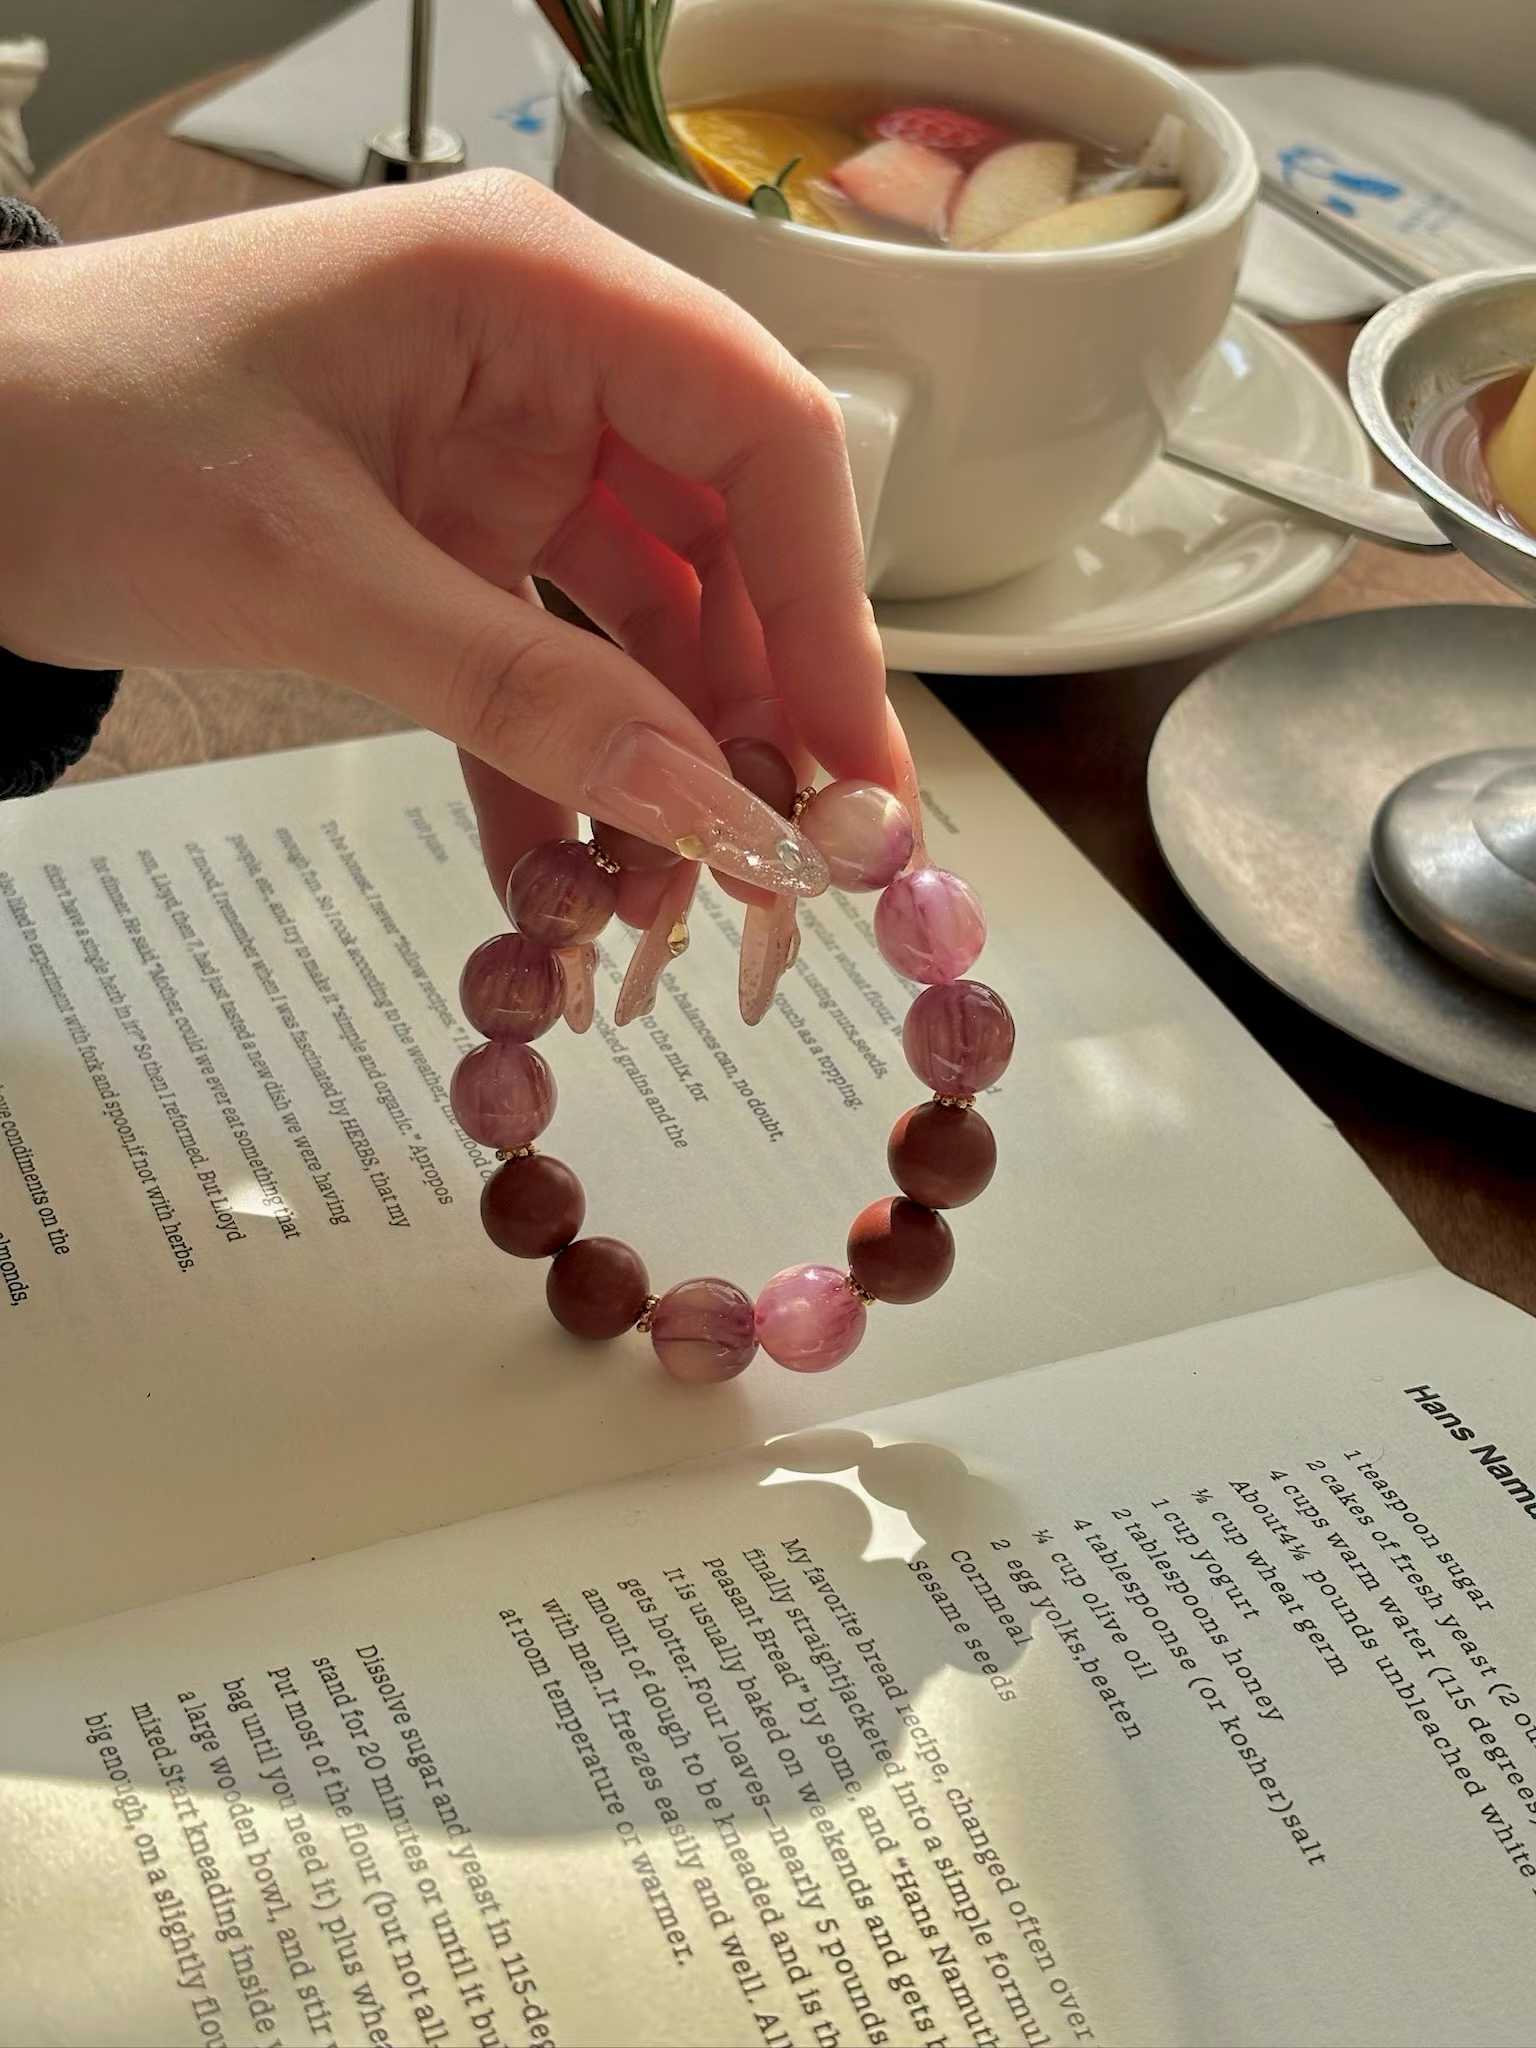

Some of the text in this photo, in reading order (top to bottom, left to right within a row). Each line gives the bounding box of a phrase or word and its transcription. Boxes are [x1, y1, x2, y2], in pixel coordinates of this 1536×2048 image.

[78, 1045, 104, 1073] fork
[92, 1074, 120, 1100] and
[132, 1158, 157, 1184] not
[146, 1185, 175, 1222] with
[162, 1222, 194, 1272] herbs.
[222, 1102, 283, 1206] eat something
[612, 1055, 688, 1148] grains and the
[665, 1052, 708, 1102] mix, for
[714, 1051, 783, 1142] can, no doubt,
[817, 1055, 863, 1110] topping.
[1, 1121, 49, 1205] condiments
[38, 1207, 58, 1227] on
[48, 1228, 70, 1255] the
[162, 1101, 246, 1242] reformed. But Lloyd
[294, 1135, 351, 1225] were having
[340, 1118, 410, 1226] HERBS, that my
[409, 1145, 453, 1205] Apropos
[1404, 1385, 1475, 1441] Hans
[617, 1579, 657, 1613] gets
[951, 1550, 1033, 1646] Cornmeal
[990, 1539, 1011, 1550] 2
[1007, 1560, 1042, 1593] egg
[1151, 1499, 1259, 1619] 1 cup yogurt
[1212, 1512, 1348, 1676] cup wheat germ
[1270, 1471, 1476, 1710] 4 cups warm water (115
[1306, 1460, 1520, 1707] 2 cakes of fresh yeast (2
[1344, 1450, 1494, 1610] 1 teaspoon sugar
[907, 1560, 1016, 1701] Sesame seeds
[1051, 1553, 1158, 1679] cup olive oil
[1074, 1520, 1092, 1531] 4
[1189, 1677, 1226, 1710] (or
[1111, 1509, 1284, 1720] 2 tablespoons honey
[499, 1609, 693, 1966] at room temperature warmer.
[702, 1558, 763, 1627] Peasant
[798, 1697, 826, 1726] by
[816, 1733, 861, 1802] some,
[857, 1805, 900, 1855] and
[742, 1548, 992, 1946] finally straightjacketed into a simple
[1302, 1570, 1536, 1877] pounds unbleached white
[85, 1713, 206, 1989] big on a slightly
[178, 1692, 332, 2033] a large bowl, and stir
[223, 1677, 364, 1976] bag until it) plus
[267, 1667, 429, 2000] Put most of the (but not
[312, 1657, 485, 2007] stand for 20 or until it
[356, 1644, 512, 1950] Dissolve sugar and yeast in
[542, 1598, 579, 1640] with
[608, 1710, 663, 1791] freezes
[693, 1877, 735, 1930] and
[721, 1932, 766, 2004] well.
[582, 1589, 822, 2016] amount of dough to be and is
[663, 1568, 935, 2032] It is usually baked on weekends and gets
[781, 1538, 812, 1563] My
[803, 1567, 863, 1637] favorite
[856, 1639, 908, 1700] bread
[946, 1789, 1020, 1895] changed
[1009, 1901, 1055, 1972] often
[1050, 1978, 1094, 2040] over
[182, 1821, 243, 1942] kneading
[228, 1945, 276, 2034] inside
[815, 1919, 839, 1934] 5
[822, 1938, 888, 2045] pounds
